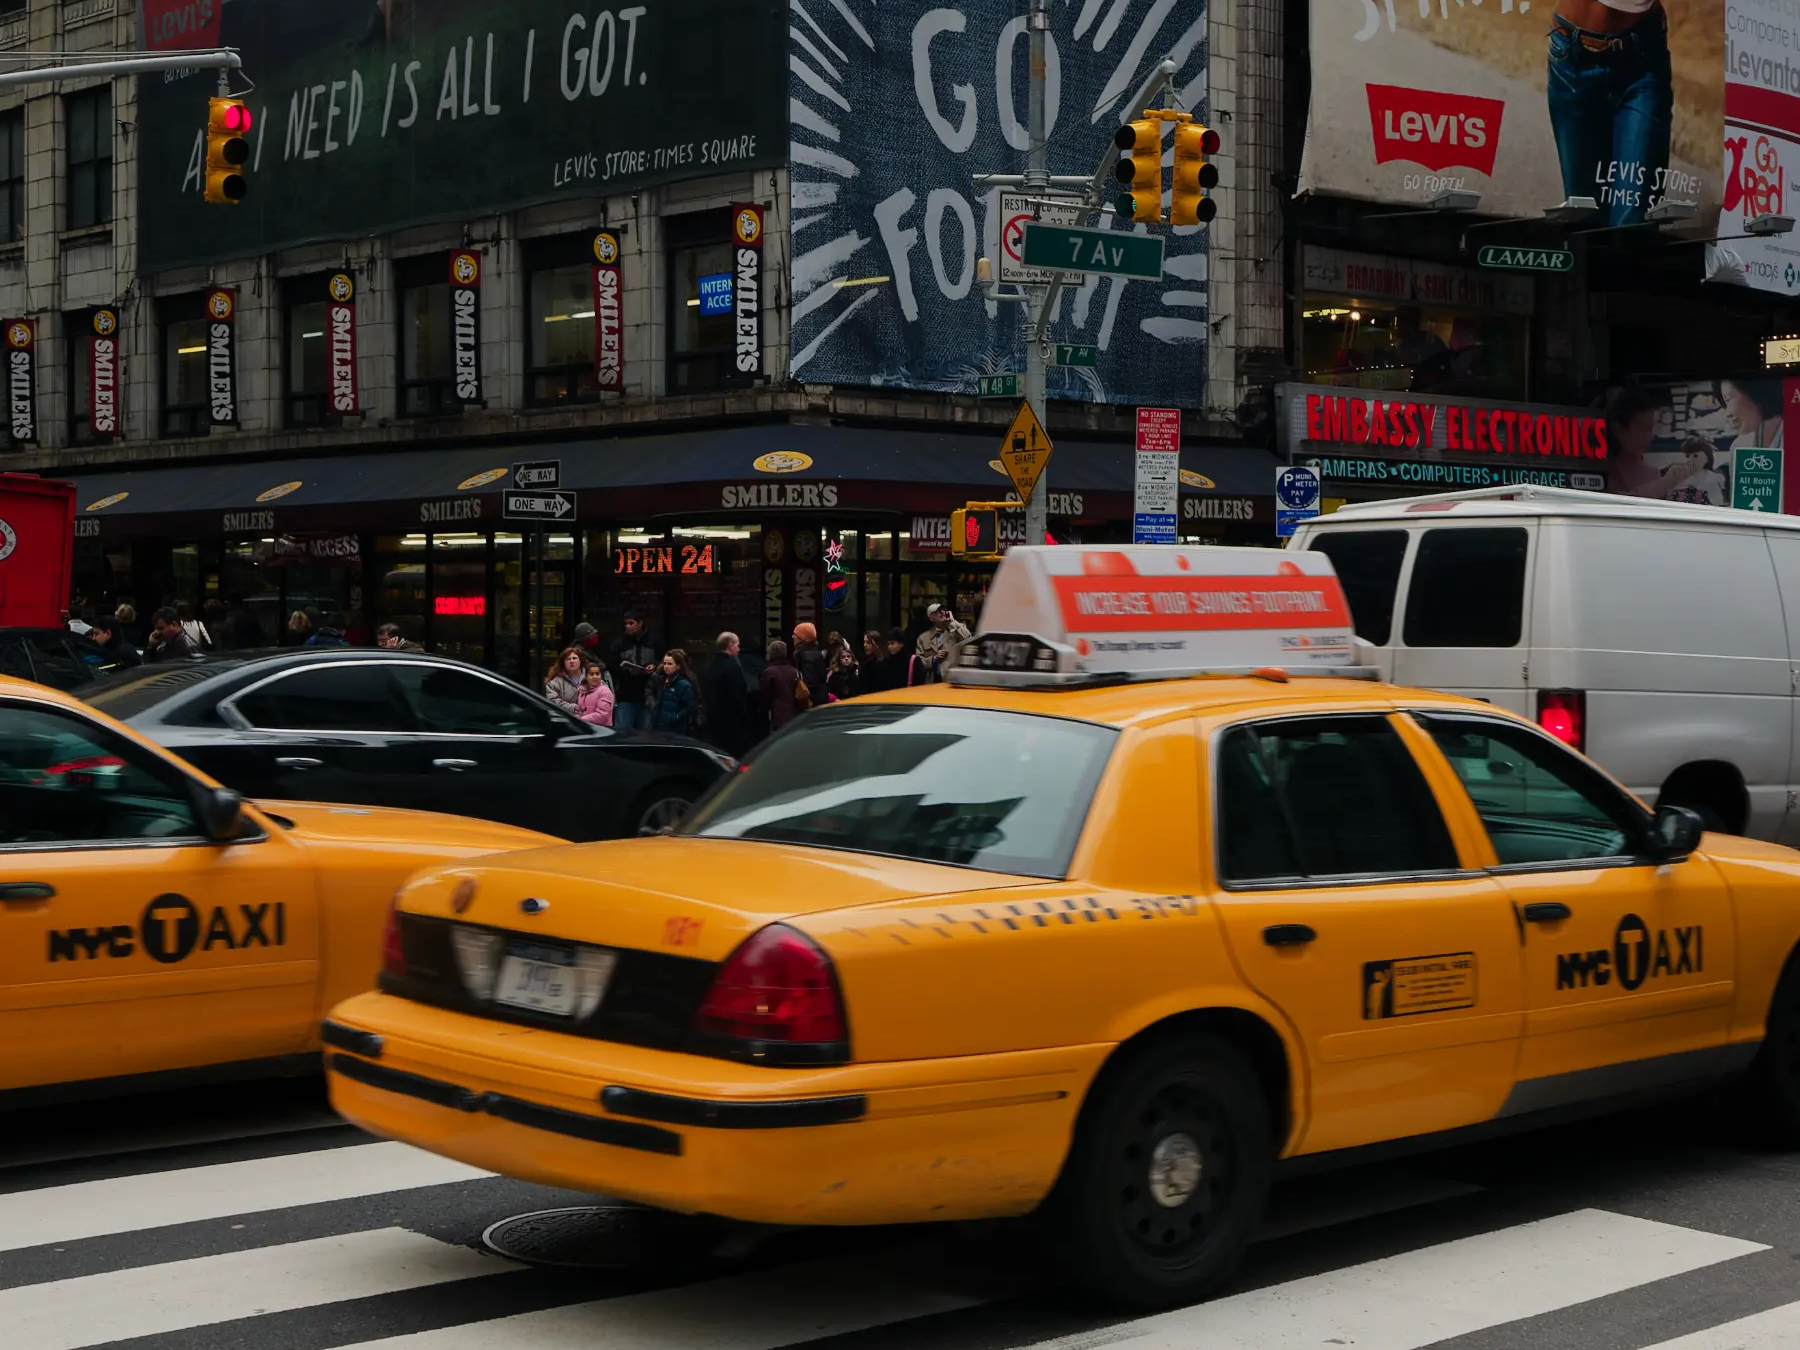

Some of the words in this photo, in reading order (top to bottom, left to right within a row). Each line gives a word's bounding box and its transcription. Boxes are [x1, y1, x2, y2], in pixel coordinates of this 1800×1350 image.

[153, 0, 213, 43] LeVI'S
[284, 69, 363, 162] NEED
[381, 60, 419, 138] IS
[436, 32, 501, 122] ALL
[523, 29, 535, 103] I
[560, 5, 648, 101] GOT.
[912, 8, 1061, 152] GO
[1384, 109, 1487, 148] LeVI'S
[554, 152, 598, 188] LEVI'S
[653, 143, 694, 169] TIMES
[701, 135, 756, 165] SQUARE
[1755, 135, 1778, 173] Go
[1403, 174, 1420, 190] GO
[1595, 160, 1647, 185] LEVI'S
[1600, 185, 1642, 207] TIMES
[1743, 165, 1783, 218] Red
[1068, 237, 1083, 262] 7
[1485, 249, 1564, 268] LAMAR
[701, 278, 733, 295] INTERN
[1346, 264, 1408, 296] BROADWAY
[707, 295, 732, 308] ACCE
[735, 248, 760, 374] SMILER'S
[596, 269, 621, 387] SMILER'S
[454, 289, 478, 401] SMILER'S
[1064, 347, 1073, 364] 7
[1078, 349, 1089, 358] AV
[330, 305, 355, 412] SMILER'S
[210, 322, 235, 422] SMILER'S
[10, 350, 33, 440] SMILER'S
[94, 338, 115, 433] SMILER'S
[981, 378, 989, 394] W
[991, 378, 1003, 394] 48
[1006, 377, 1015, 386] ST
[1305, 394, 1437, 449] EMBASSY
[1445, 405, 1608, 461] ELECTRONICS
[1014, 453, 1036, 465] SHARE
[519, 471, 532, 482] ONE
[537, 470, 553, 481] WAY
[1016, 478, 1033, 488] ROAD
[1283, 473, 1294, 487] P
[1400, 463, 1491, 486] COMPUTERS
[1502, 469, 1567, 488] LUGGAGE
[1739, 477, 1751, 485] Alt
[1753, 477, 1776, 486] Route
[722, 483, 838, 508] SMILER'S
[1005, 492, 1084, 516] SER'S
[1741, 486, 1773, 497] South
[420, 499, 482, 523] SMILER'S
[514, 499, 535, 510] ONE
[544, 500, 565, 511] WAY
[1184, 498, 1254, 520] SMILER'S
[74, 517, 100, 537] LER'S
[223, 510, 275, 533] SMILER'S
[912, 517, 951, 538] INTE
[998, 518, 1026, 539] CCE
[1145, 516, 1158, 525] Pay
[310, 534, 359, 557] ACCESS
[680, 544, 713, 574] 24
[46, 925, 135, 963] NYC
[142, 893, 286, 963] TAXI
[1555, 950, 1611, 991] NYC
[1616, 914, 1704, 990] TAXI
